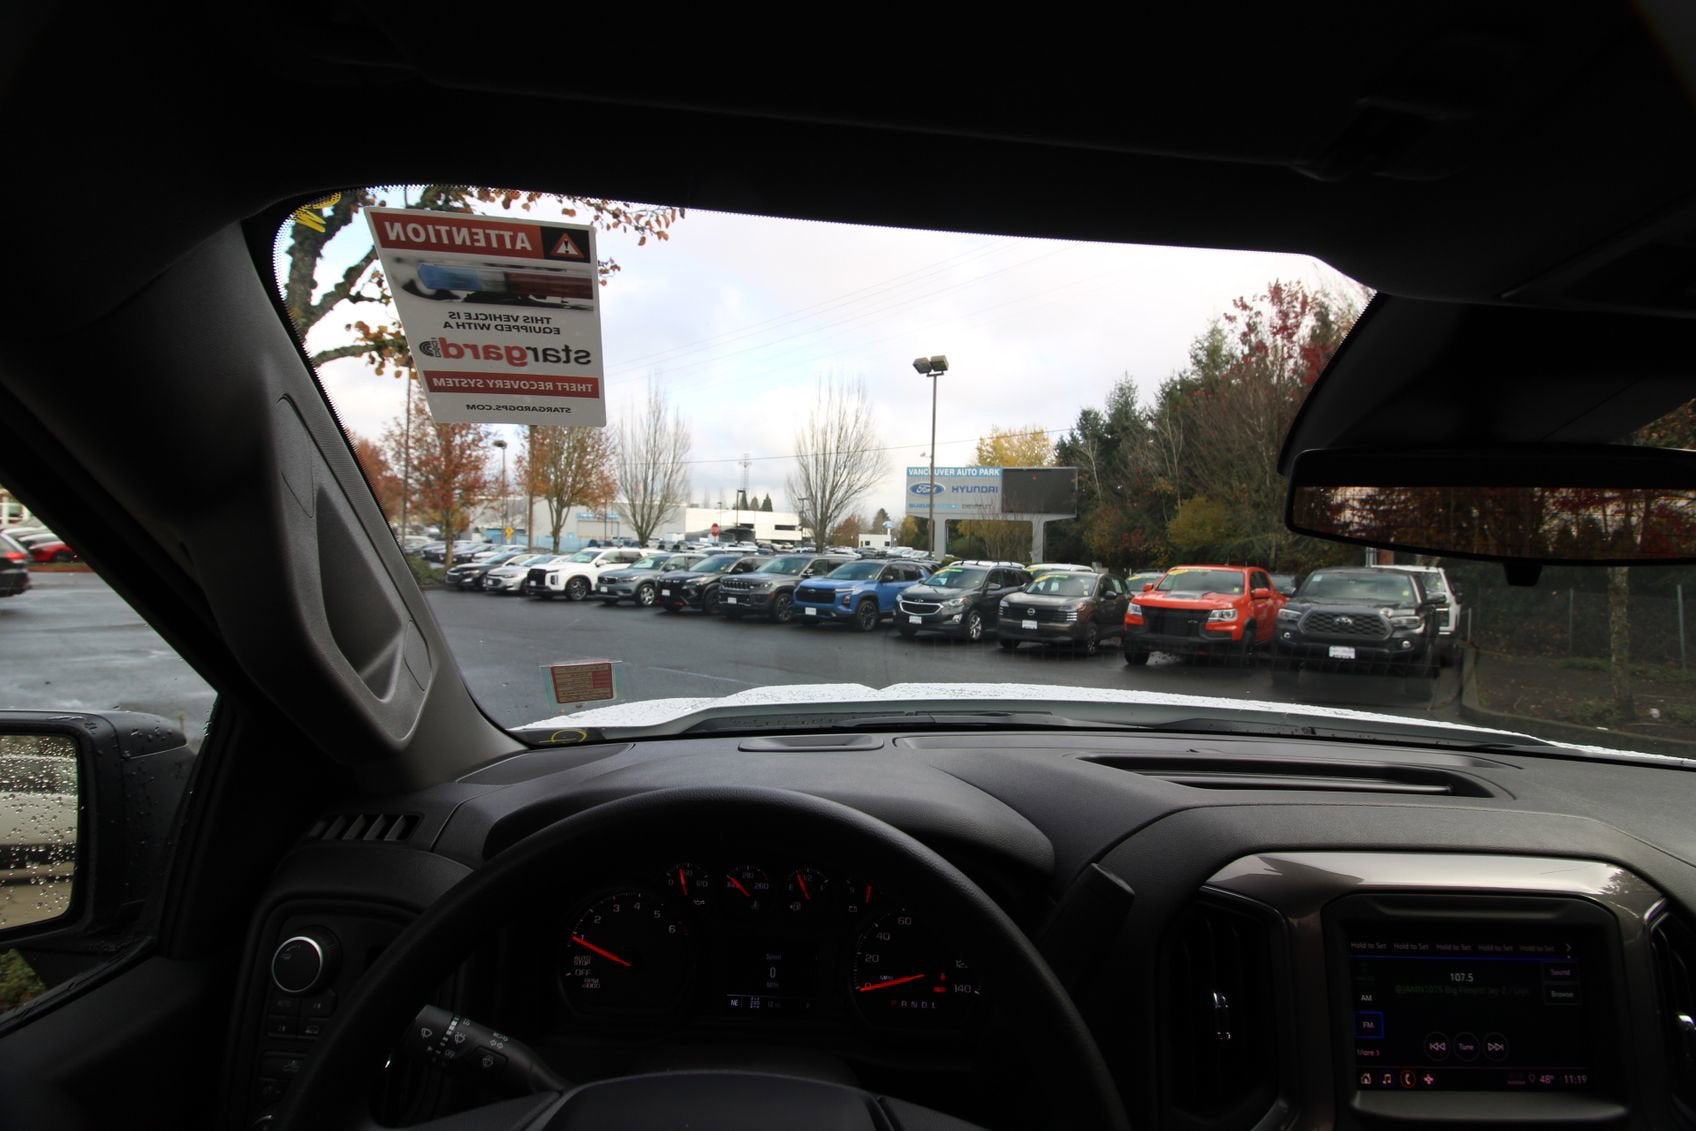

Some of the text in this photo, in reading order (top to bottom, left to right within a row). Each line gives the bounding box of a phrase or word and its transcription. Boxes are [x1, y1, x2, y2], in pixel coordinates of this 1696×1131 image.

[908, 468, 1000, 476] VANCUVER AUTO PARK
[951, 485, 999, 494] HYUNDAI
[612, 904, 620, 912] 3
[634, 902, 640, 911] 4
[654, 910, 661, 919] 5
[593, 915, 602, 924] 2
[897, 916, 912, 926] 60
[668, 924, 676, 934] 6
[876, 932, 891, 941] 40
[865, 954, 880, 963] 20
[770, 966, 776, 978] 0
[1450, 972, 1474, 984] 107.5
[953, 984, 972, 993] 140
[1360, 994, 1373, 1002] AM
[1564, 1074, 1588, 1084] 11:19
